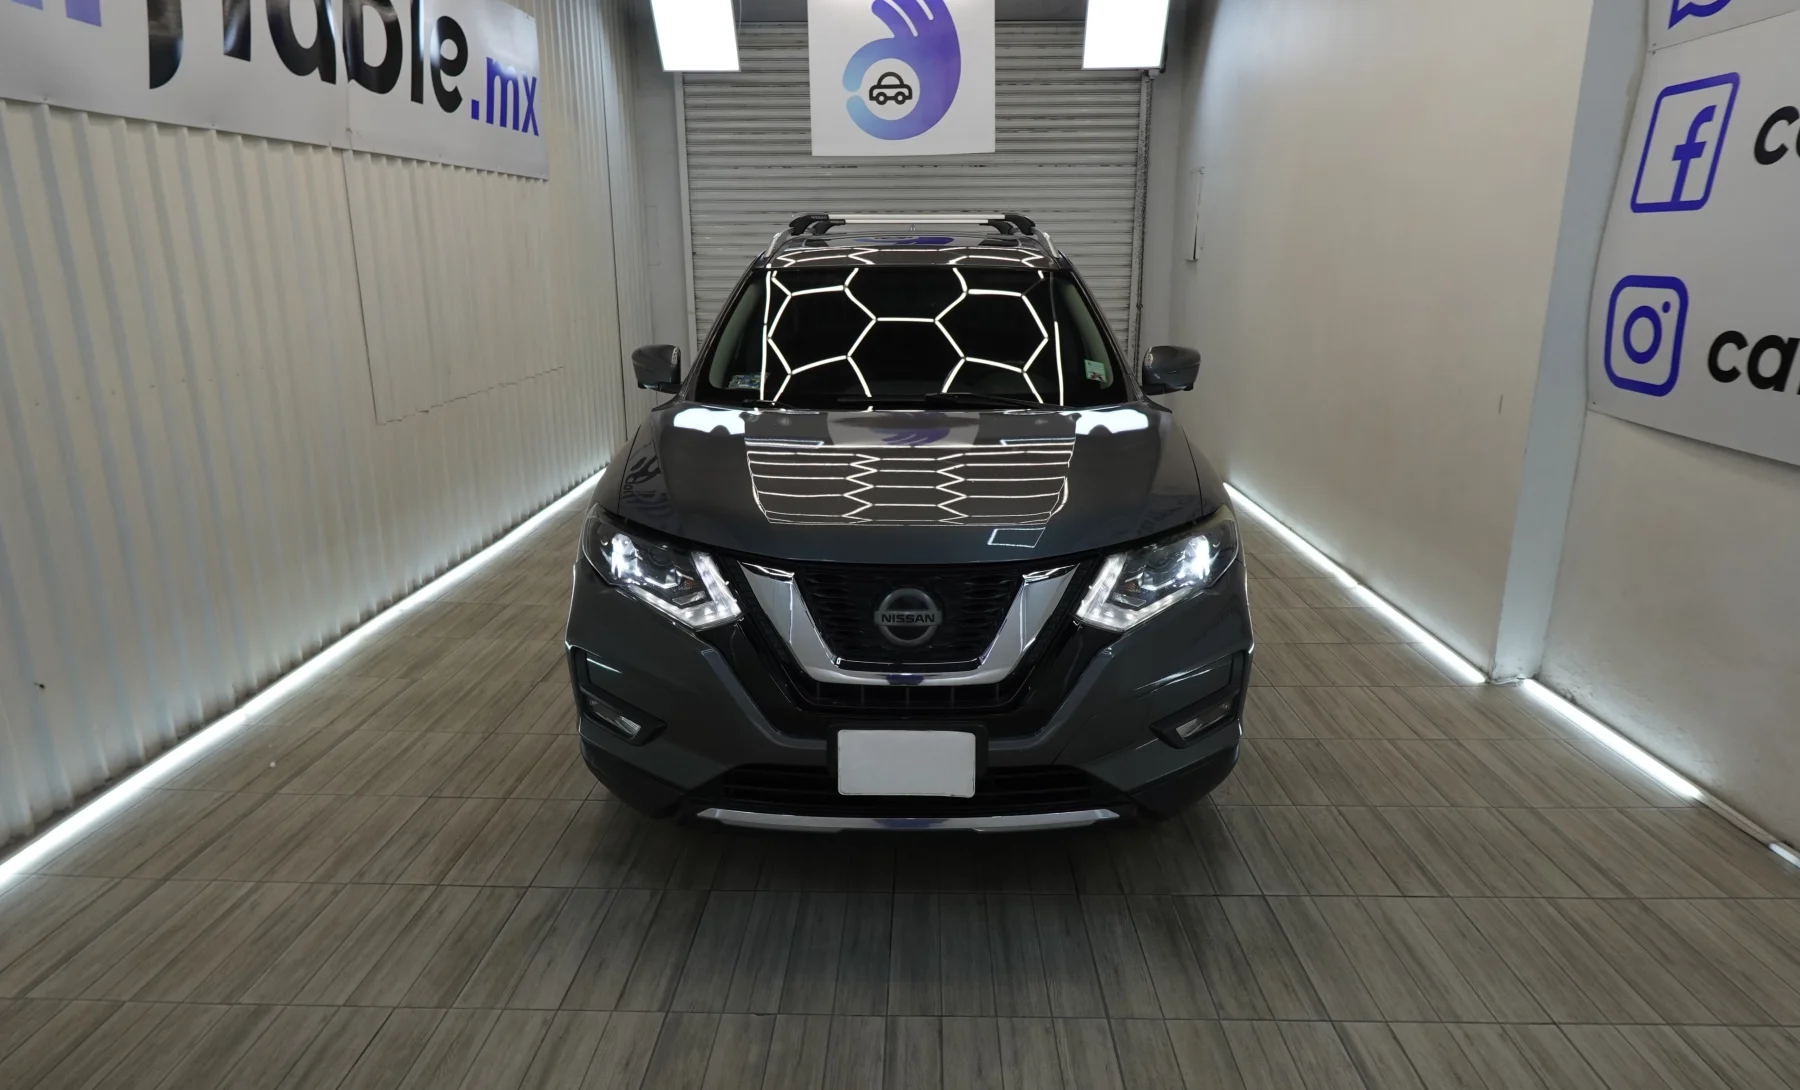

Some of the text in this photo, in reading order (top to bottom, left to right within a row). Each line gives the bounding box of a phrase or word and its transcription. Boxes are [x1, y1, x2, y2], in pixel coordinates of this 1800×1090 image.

[8, 0, 540, 136] able.mx
[1754, 105, 1800, 165] c
[1707, 330, 1800, 395] ca
[881, 613, 935, 623] NISSAN
